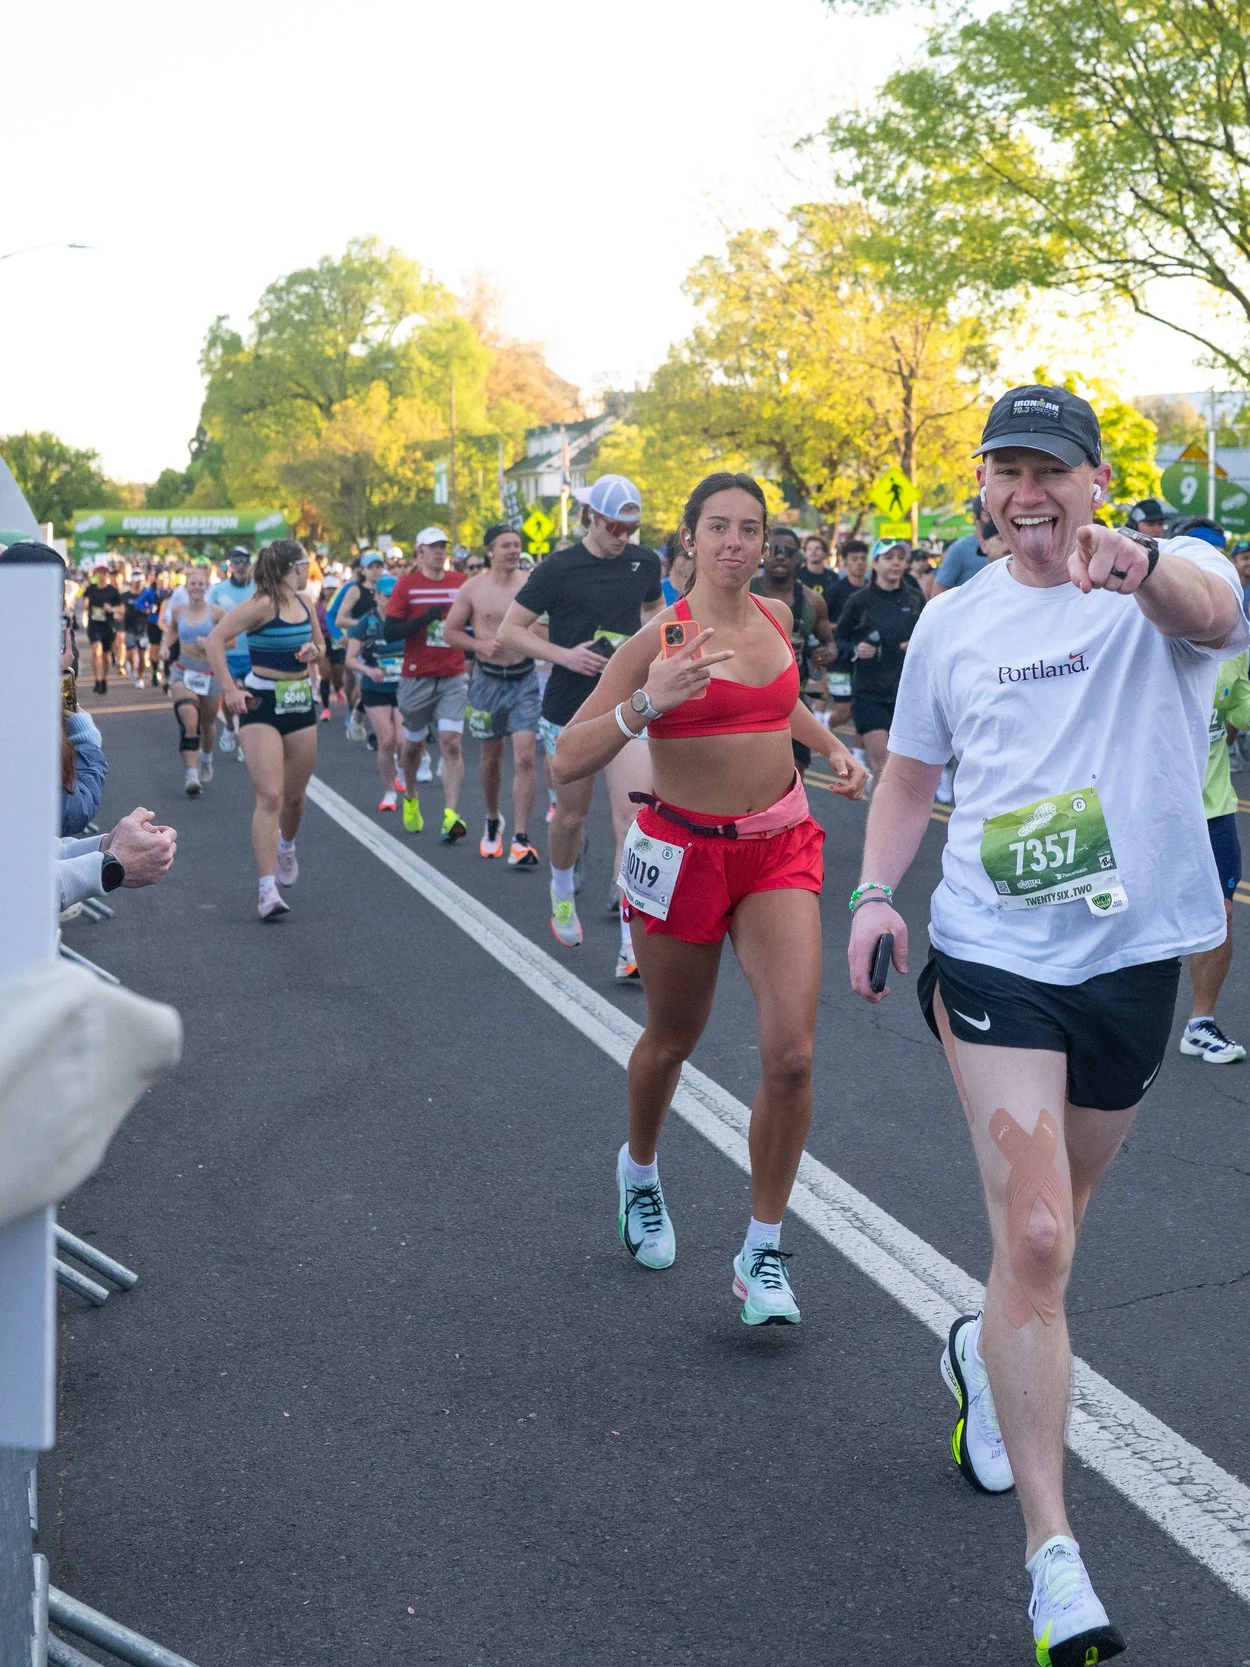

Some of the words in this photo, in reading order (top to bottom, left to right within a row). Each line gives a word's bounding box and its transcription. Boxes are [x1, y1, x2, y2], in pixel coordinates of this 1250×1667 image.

[1013, 398, 1060, 411] IRONMAN
[1013, 406, 1030, 414] 70.3
[1180, 476, 1198, 505] 9
[122, 516, 168, 529] EUGENE
[170, 516, 239, 529] MARATHON
[1077, 801, 1082, 809] C
[1009, 829, 1076, 876] 7357
[1025, 892, 1056, 906] TWENTY
